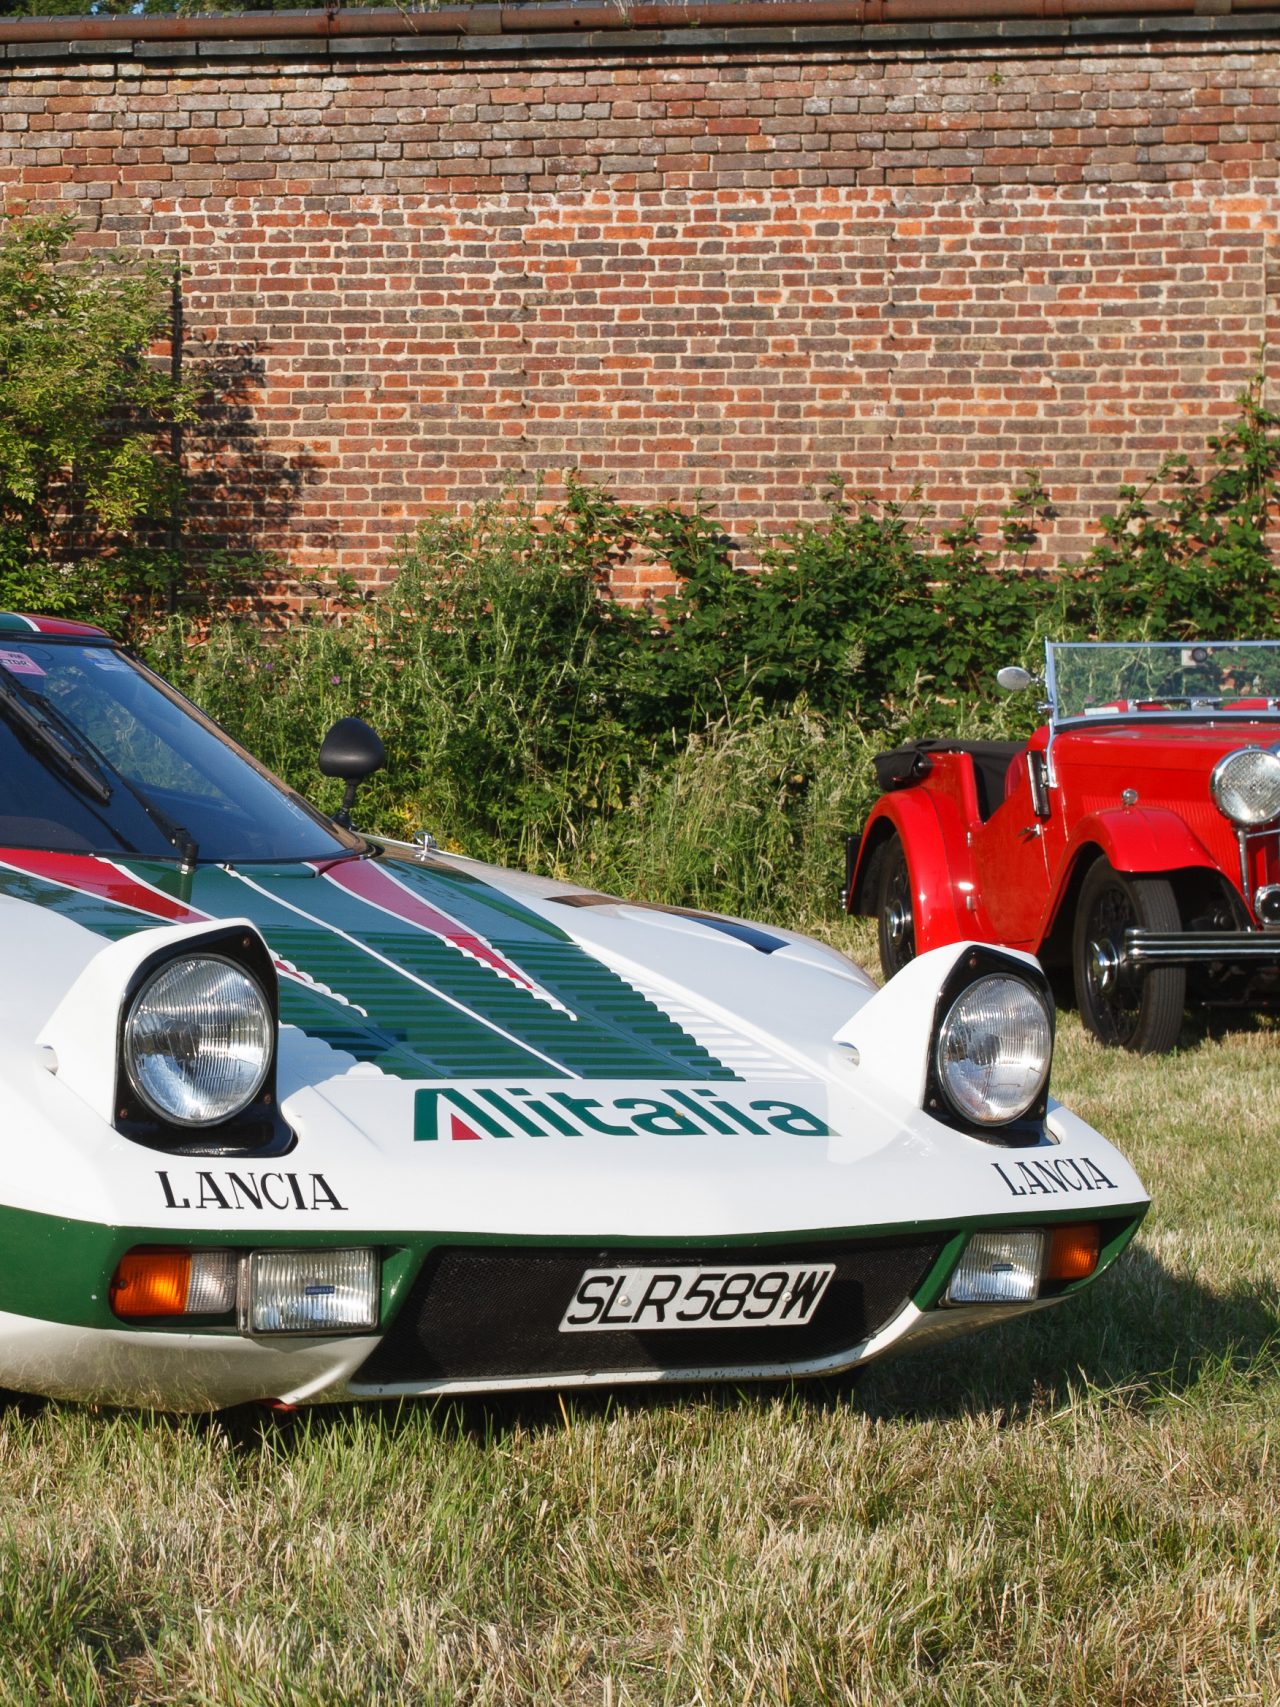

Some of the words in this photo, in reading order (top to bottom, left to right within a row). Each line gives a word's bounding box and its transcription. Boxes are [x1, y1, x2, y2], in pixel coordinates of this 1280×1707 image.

[413, 1087, 841, 1141] Alitalia
[155, 1170, 349, 1211] LANCIA
[990, 1157, 1120, 1196] LANCIA
